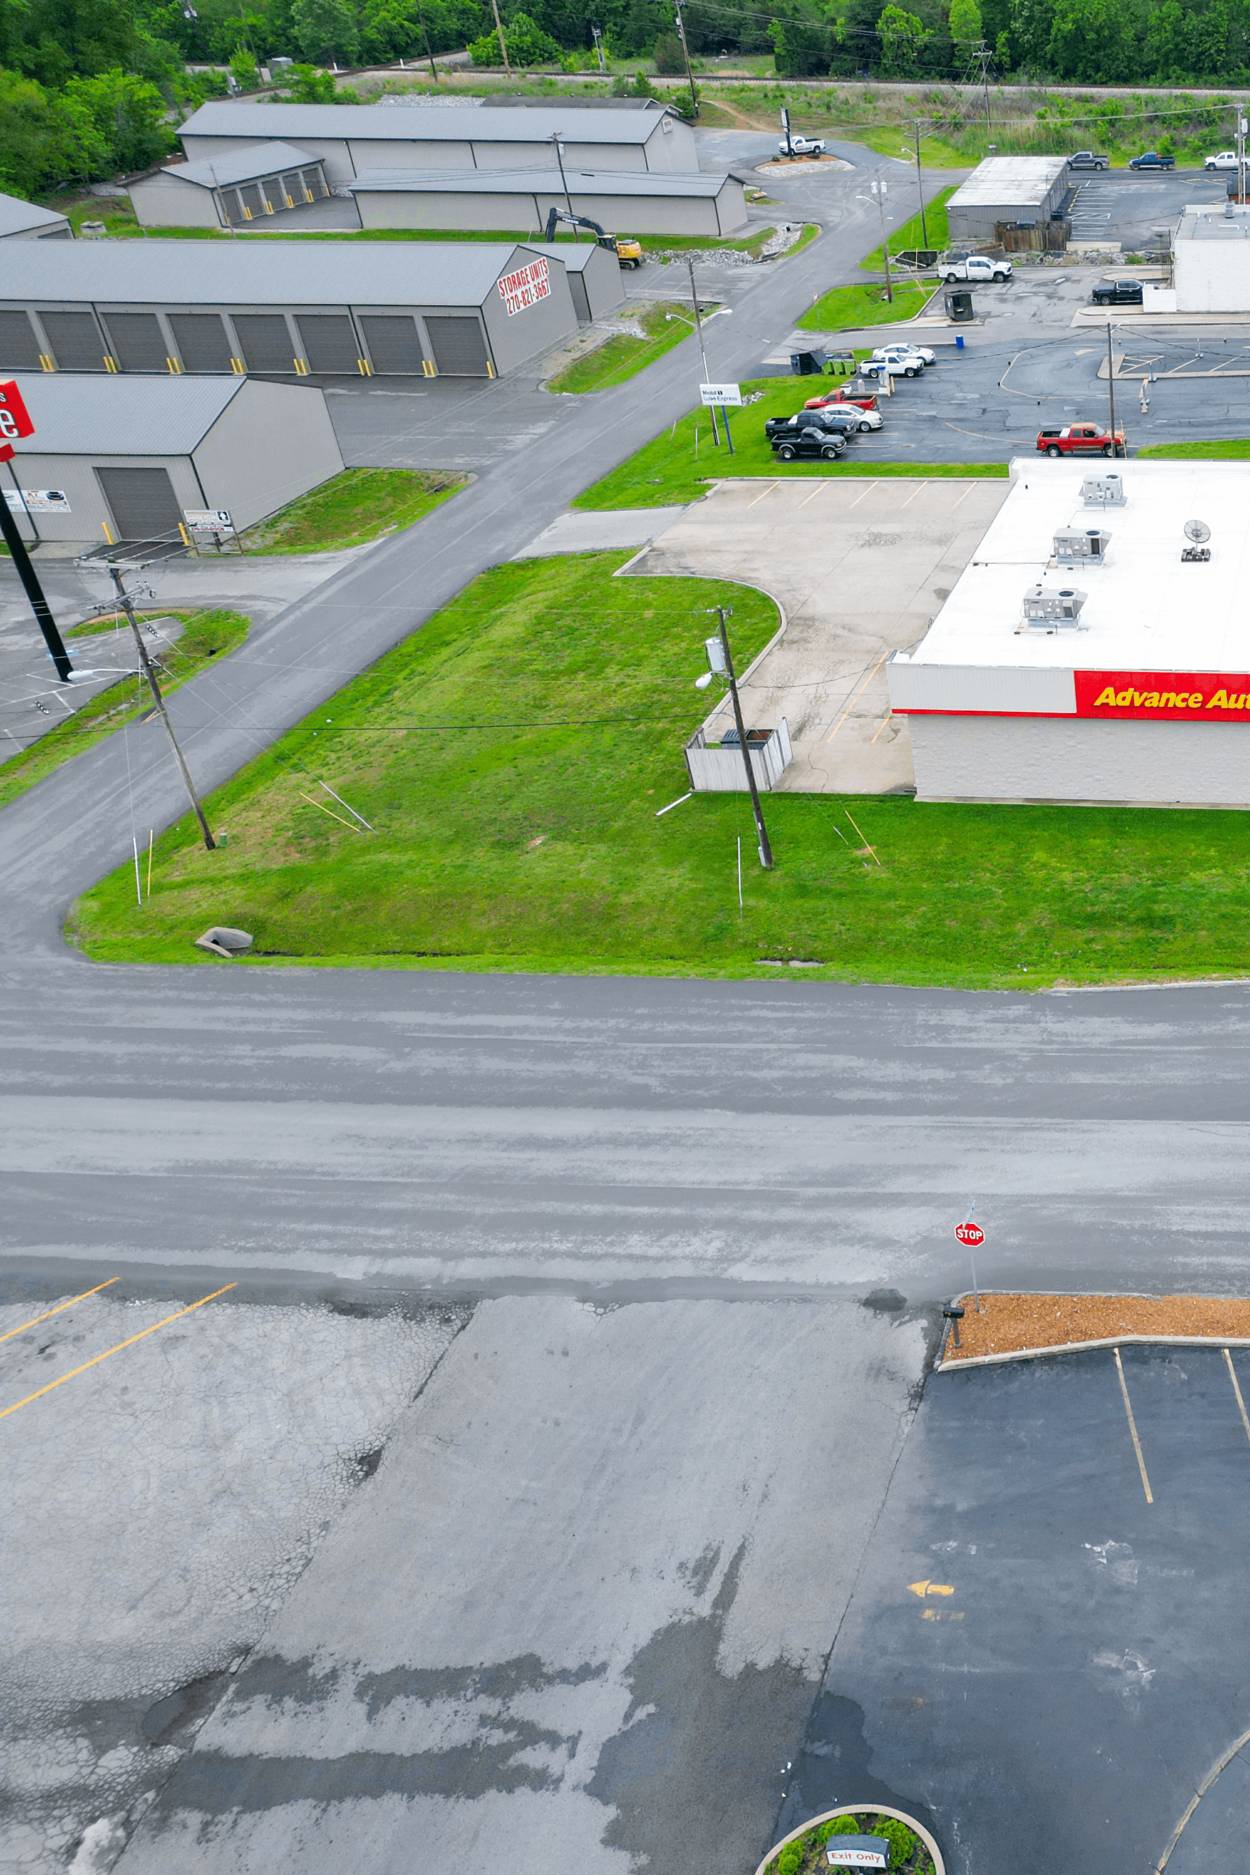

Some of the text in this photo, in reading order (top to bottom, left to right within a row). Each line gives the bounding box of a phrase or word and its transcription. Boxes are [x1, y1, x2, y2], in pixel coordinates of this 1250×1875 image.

[499, 258, 548, 297] STORAGE UNITS
[1094, 687, 1202, 708] Advance
[957, 1229, 983, 1240] STOP
[831, 1852, 881, 1863] Exit Only
